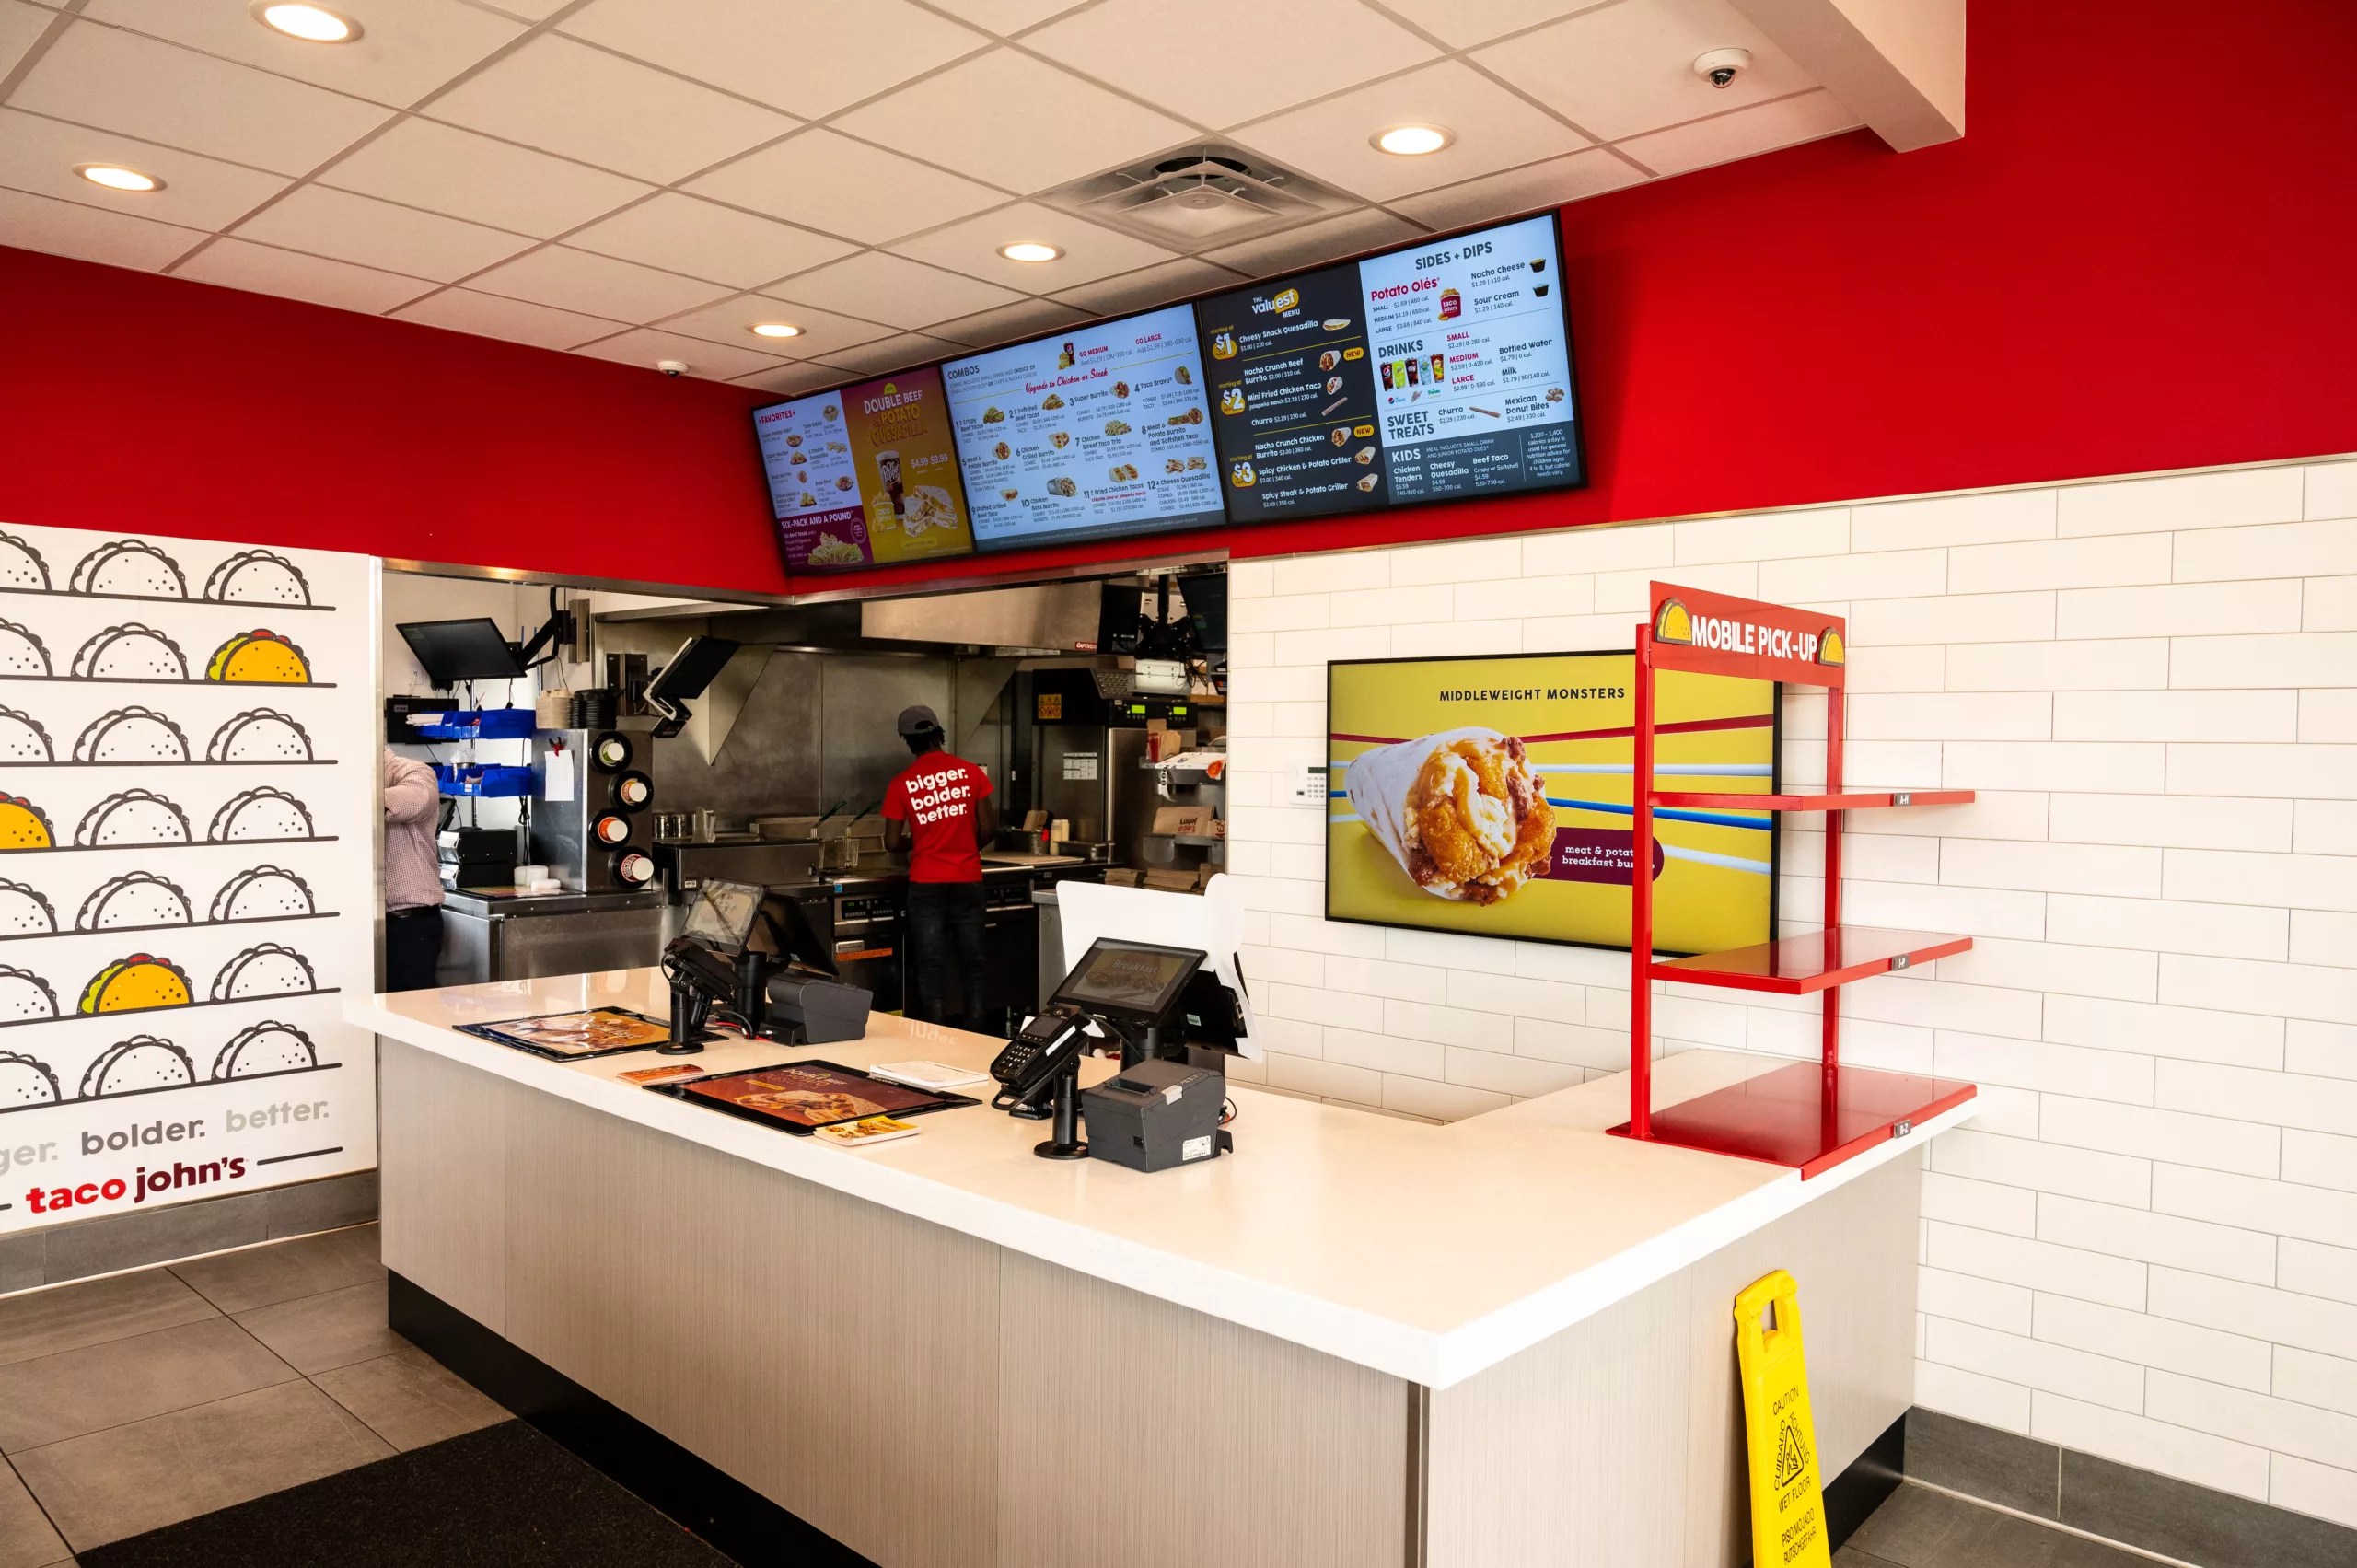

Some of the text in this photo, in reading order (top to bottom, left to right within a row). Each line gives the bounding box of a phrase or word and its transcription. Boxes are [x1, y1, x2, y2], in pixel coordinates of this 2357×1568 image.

[1415, 242, 1492, 271] SIDES DIPS
[1471, 261, 1525, 279] Nacho Cheese
[1371, 283, 1409, 301] Potato
[1474, 290, 1519, 305] Sour Cream
[1283, 308, 1300, 318] MENU
[1374, 315, 1394, 323] MEDIUM
[1144, 333, 1162, 343] LARGE
[1239, 320, 1318, 343] Cheesy Snack Quesadilla
[1447, 331, 1469, 342] SMALL
[1088, 346, 1108, 355] MEDIUM
[1215, 333, 1232, 354] $1
[1378, 339, 1423, 358] DRINKS
[1499, 339, 1552, 354] Bottled Water
[1346, 350, 1361, 358] NEW
[1450, 353, 1479, 363] MEDIUM
[948, 366, 980, 379] COMBOS
[1244, 358, 1303, 376] Nacho Crunch Beef
[1502, 367, 1517, 376] Milk
[1026, 383, 1048, 393] Upgrade
[1057, 373, 1079, 386] Chicken
[1245, 375, 1267, 385] Burrito
[1452, 375, 1474, 384] LARGE
[1090, 390, 1108, 399] Burrito
[1224, 388, 1244, 410] $2
[1248, 383, 1321, 401] Mini Fried Chicken Taco
[864, 390, 922, 415] DOUBLE BEEF
[1505, 395, 1537, 406] Mexican
[1506, 402, 1550, 414] Donut Bites
[761, 410, 792, 424] FAVORITES
[881, 404, 920, 424] POTATO
[1438, 406, 1463, 415] Churro
[1251, 417, 1272, 426] Churro
[1387, 411, 1429, 427] SWEET
[1389, 424, 1434, 440] TREATS
[1162, 436, 1184, 445] Softshell
[1255, 435, 1324, 450] Nacho Crunch Chicken
[1256, 449, 1278, 459] Burrito
[1392, 449, 1421, 463] KIDS
[1473, 454, 1509, 464] Beef Taco
[1276, 462, 1301, 472] Chicken
[1308, 460, 1329, 469] Potato
[1331, 456, 1352, 465] Griller
[1394, 466, 1420, 474] Chicken
[1430, 461, 1456, 470] Cheesy
[1234, 462, 1253, 482] $3
[1395, 474, 1422, 482] Tenders
[1431, 467, 1469, 479] Quesadilla
[1109, 484, 1128, 494] Chicken
[1147, 481, 1156, 490] 12
[1181, 473, 1210, 482] Quesadilla
[1280, 488, 1298, 497] Steak
[1306, 486, 1326, 494] Potato
[1328, 482, 1348, 491] Griller
[1021, 499, 1029, 507] 10
[782, 518, 808, 529] SIX-PACK
[829, 512, 851, 522] POUND
[1691, 615, 1817, 661] MOBILE PICK-UP
[1440, 688, 1625, 702] MIDDLEWEIGHT MONSTERS
[905, 768, 969, 794] bigger.
[911, 785, 970, 811] bolder.
[916, 802, 967, 825] better.
[1606, 848, 1633, 857] potat
[1562, 856, 1613, 867] breakfast
[1112, 960, 1158, 973] Breakfast
[81, 1118, 205, 1156] bolder.
[226, 1099, 330, 1133] better.
[26, 1156, 245, 1214] taco john's
[1773, 1385, 1799, 1415] CAUTION
[1789, 1412, 1810, 1464] ACHTUNG
[1774, 1420, 1785, 1491] CUIDADO
[1779, 1476, 1810, 1513] WET FLOOR
[1782, 1508, 1814, 1547] PISO MOJADO
[1784, 1526, 1816, 1566] RUTSCHGEFAHR
